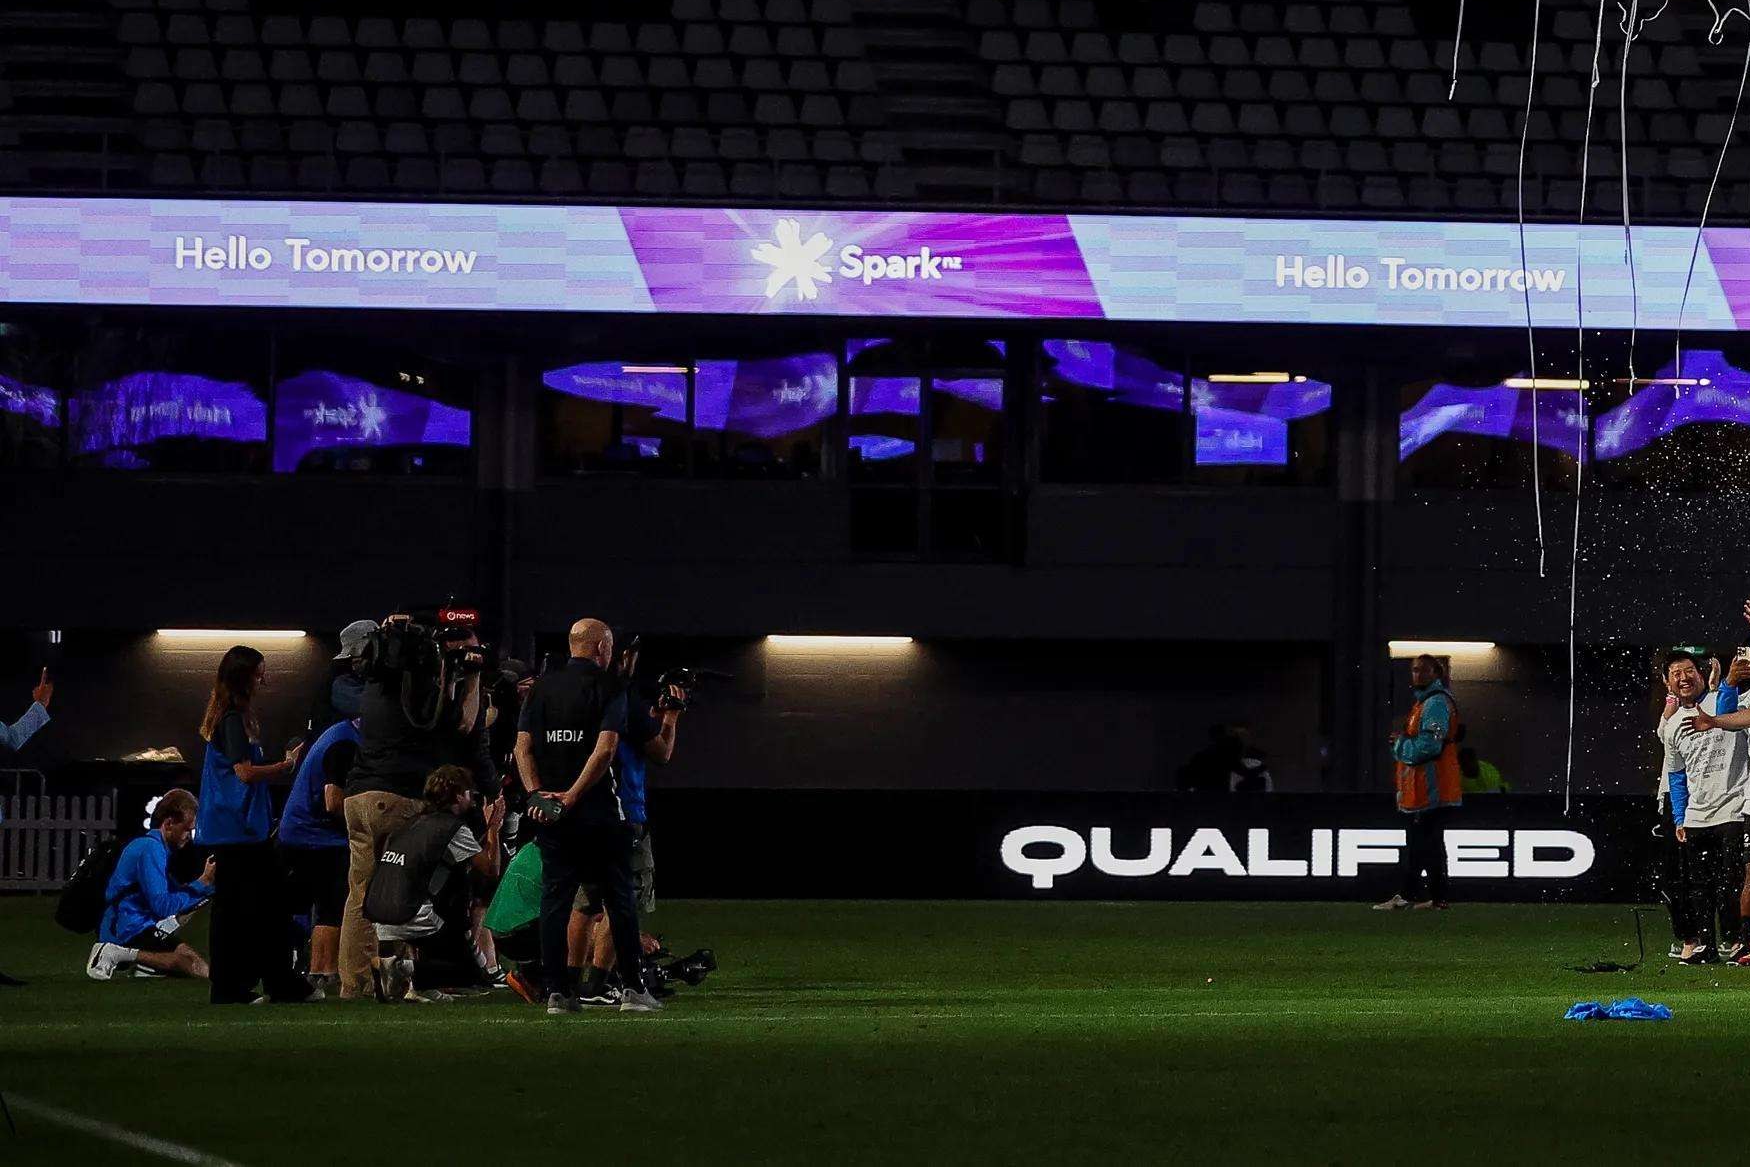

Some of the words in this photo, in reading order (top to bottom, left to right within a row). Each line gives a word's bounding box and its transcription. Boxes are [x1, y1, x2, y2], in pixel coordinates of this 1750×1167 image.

[175, 235, 272, 270] Hello
[284, 238, 477, 274] Tomorrow
[839, 244, 942, 285] Spark
[1276, 254, 1369, 289] Hello
[1380, 257, 1566, 292] Tomorrow
[381, 850, 405, 866] EDIA
[1000, 825, 1596, 889] QUALIFED
